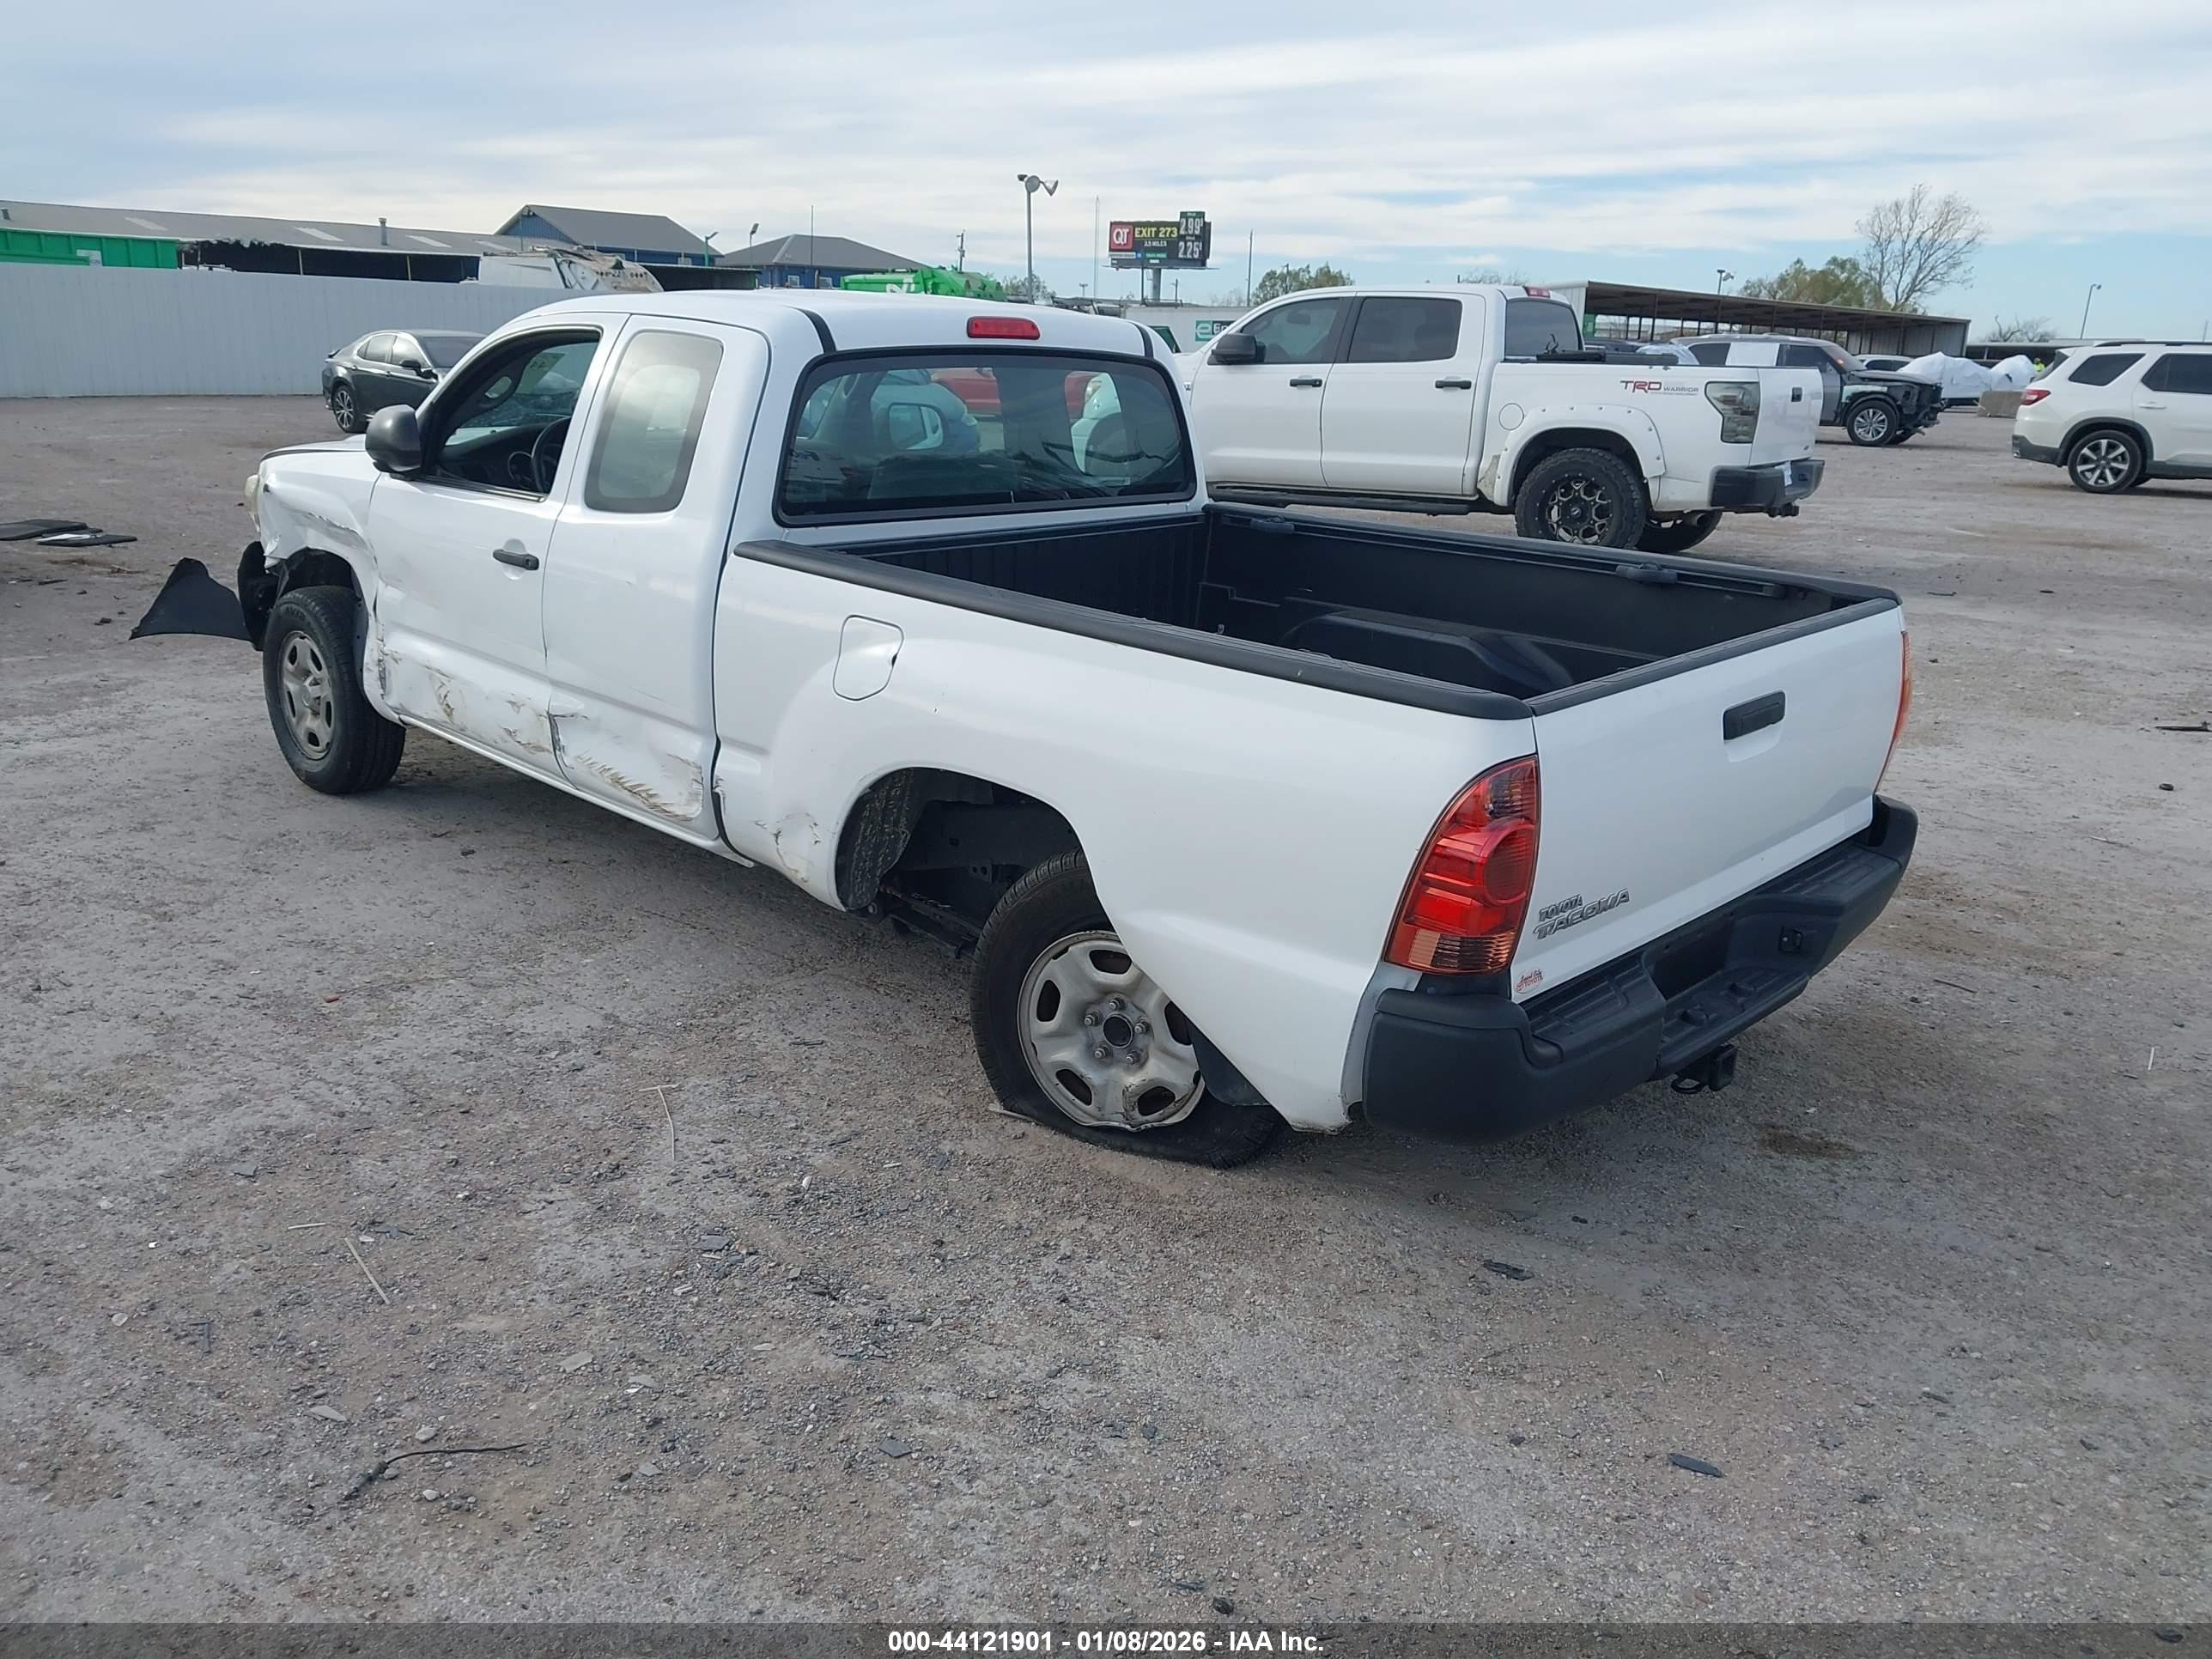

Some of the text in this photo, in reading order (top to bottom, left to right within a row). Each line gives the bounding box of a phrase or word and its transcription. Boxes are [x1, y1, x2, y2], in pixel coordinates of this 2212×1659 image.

[1113, 228, 1129, 245] QT
[1134, 227, 1157, 238] EXIT
[1158, 227, 1178, 238] 273
[1620, 380, 1662, 393] TRD
[1532, 888, 1631, 940] TACOMA
[1538, 894, 1583, 922] TOYOTA
